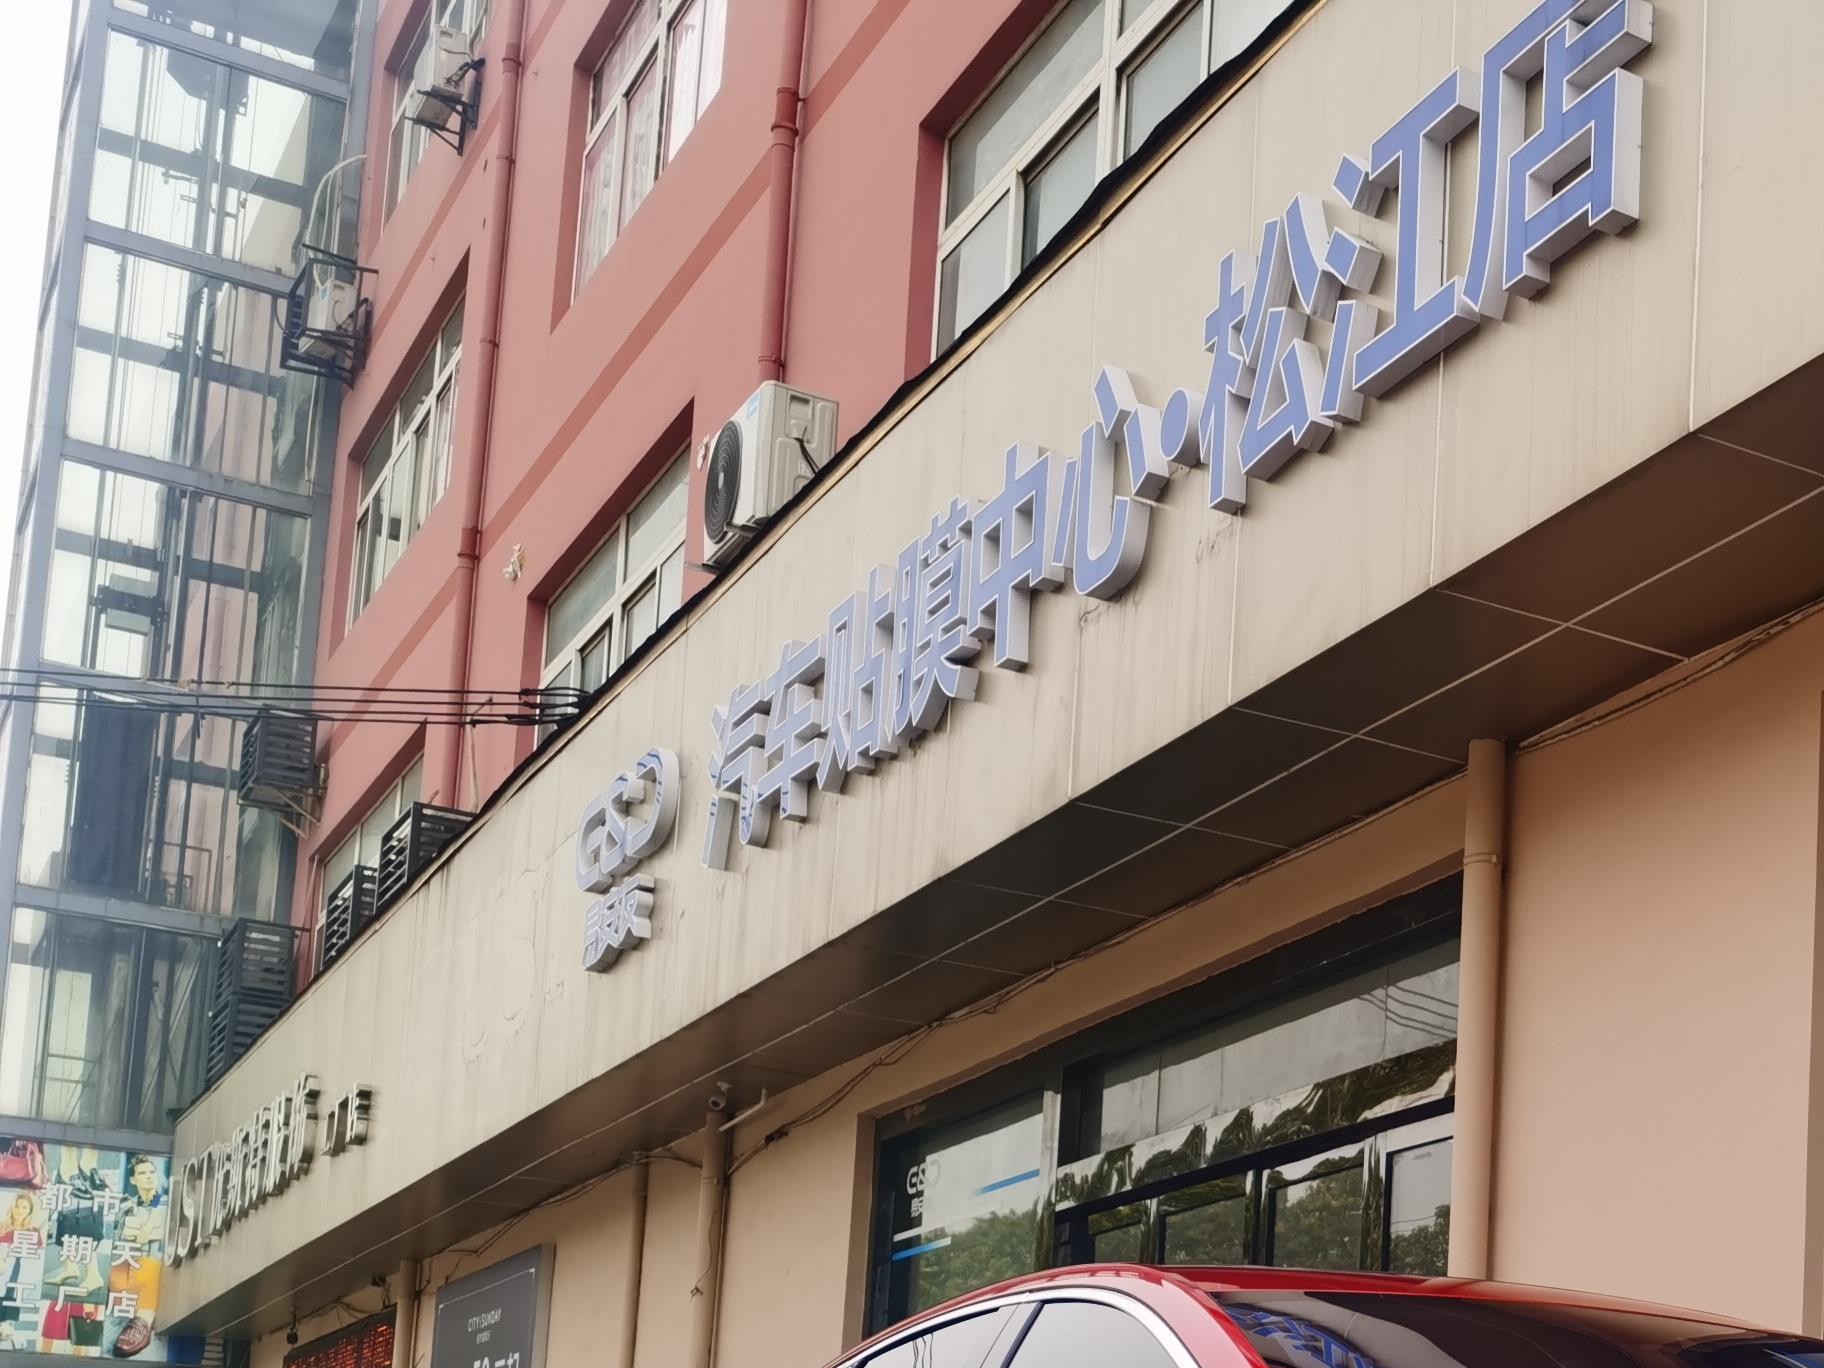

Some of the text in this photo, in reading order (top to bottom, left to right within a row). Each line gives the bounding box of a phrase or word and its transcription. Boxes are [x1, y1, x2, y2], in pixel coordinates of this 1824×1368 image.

[40, 1184, 125, 1219] 都市
[8, 1230, 143, 1270] 星期天
[1, 1282, 139, 1320] 工厂店
